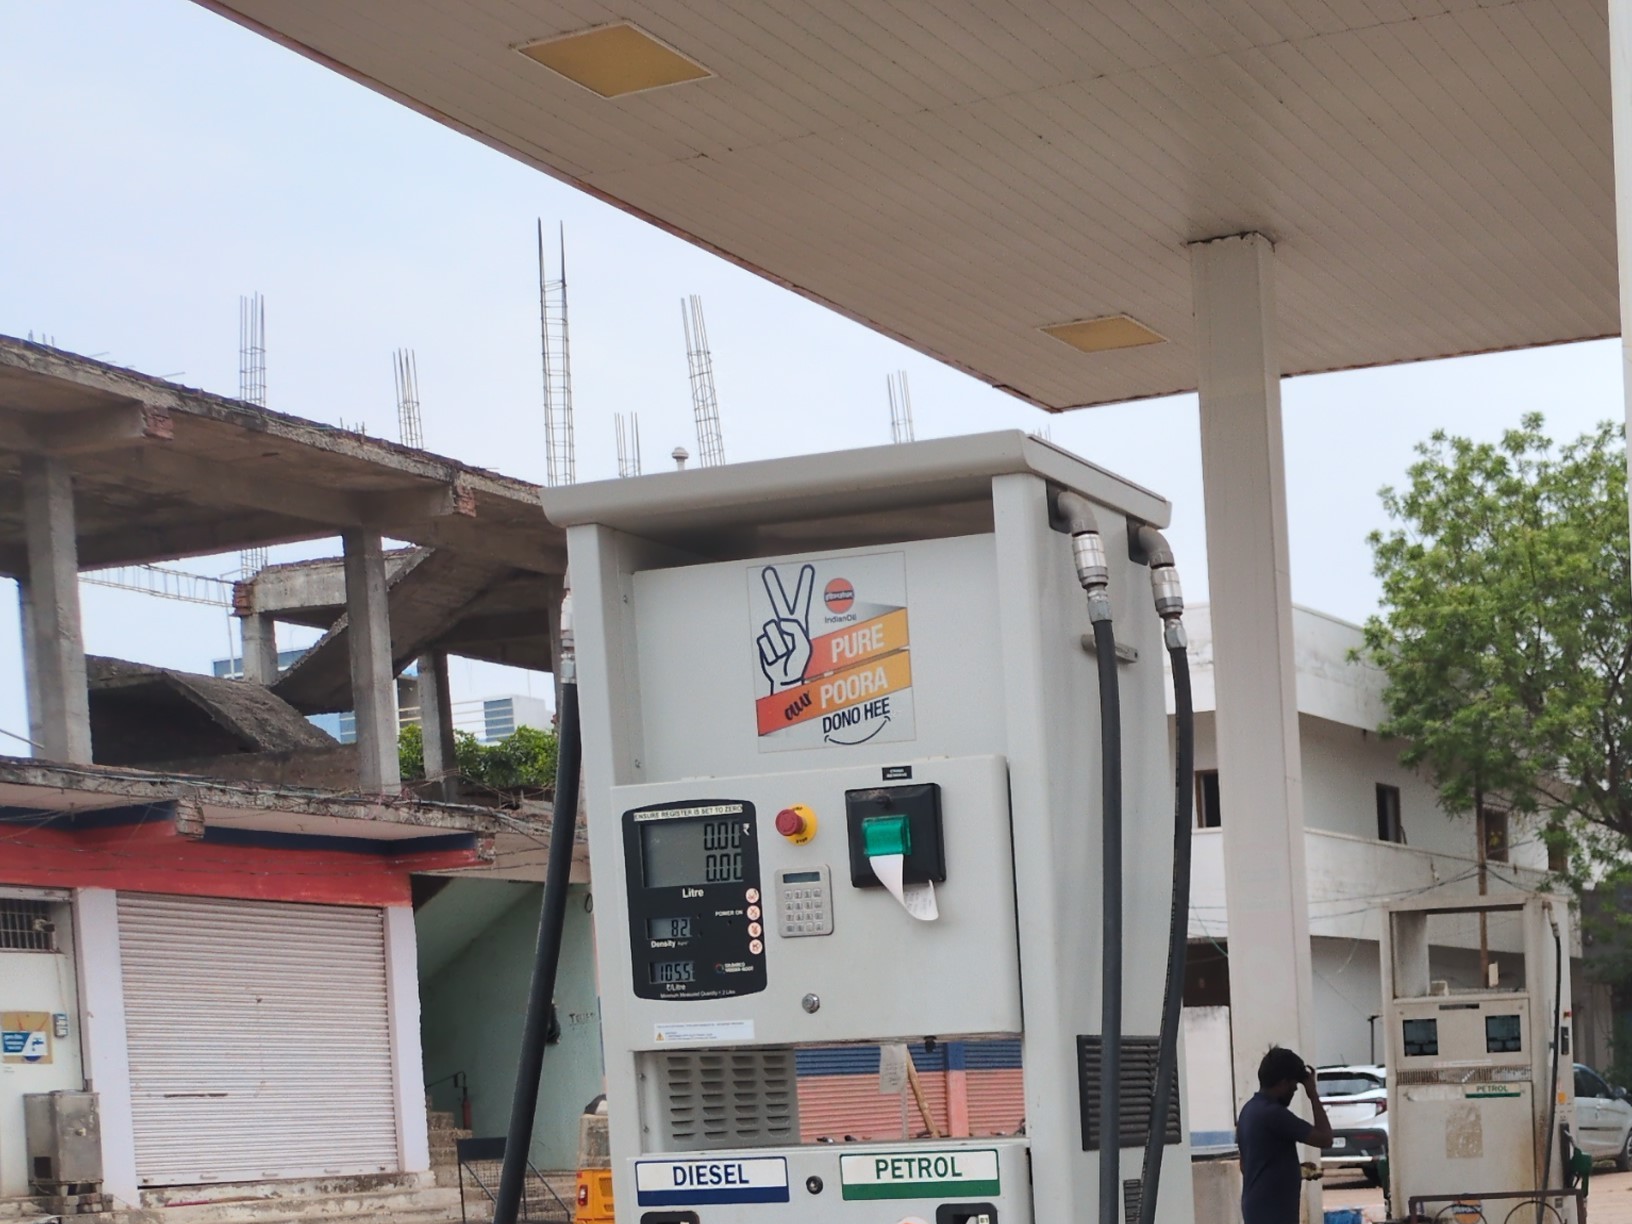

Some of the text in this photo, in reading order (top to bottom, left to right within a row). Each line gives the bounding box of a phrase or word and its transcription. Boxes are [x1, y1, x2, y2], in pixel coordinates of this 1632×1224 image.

[831, 623, 885, 664] PURE
[820, 667, 888, 709] POORA
[822, 697, 890, 734] DONO HEE
[634, 811, 660, 820] ENSURE
[661, 809, 692, 818] REGISTER
[701, 807, 713, 815] SET
[714, 806, 723, 814] TO
[725, 805, 742, 814] ZERO
[682, 887, 704, 899] Litre
[651, 940, 676, 949] Density
[1476, 1085, 1508, 1093] PETROL
[672, 1164, 749, 1186] DIESEL
[875, 1156, 963, 1180] PETROL
